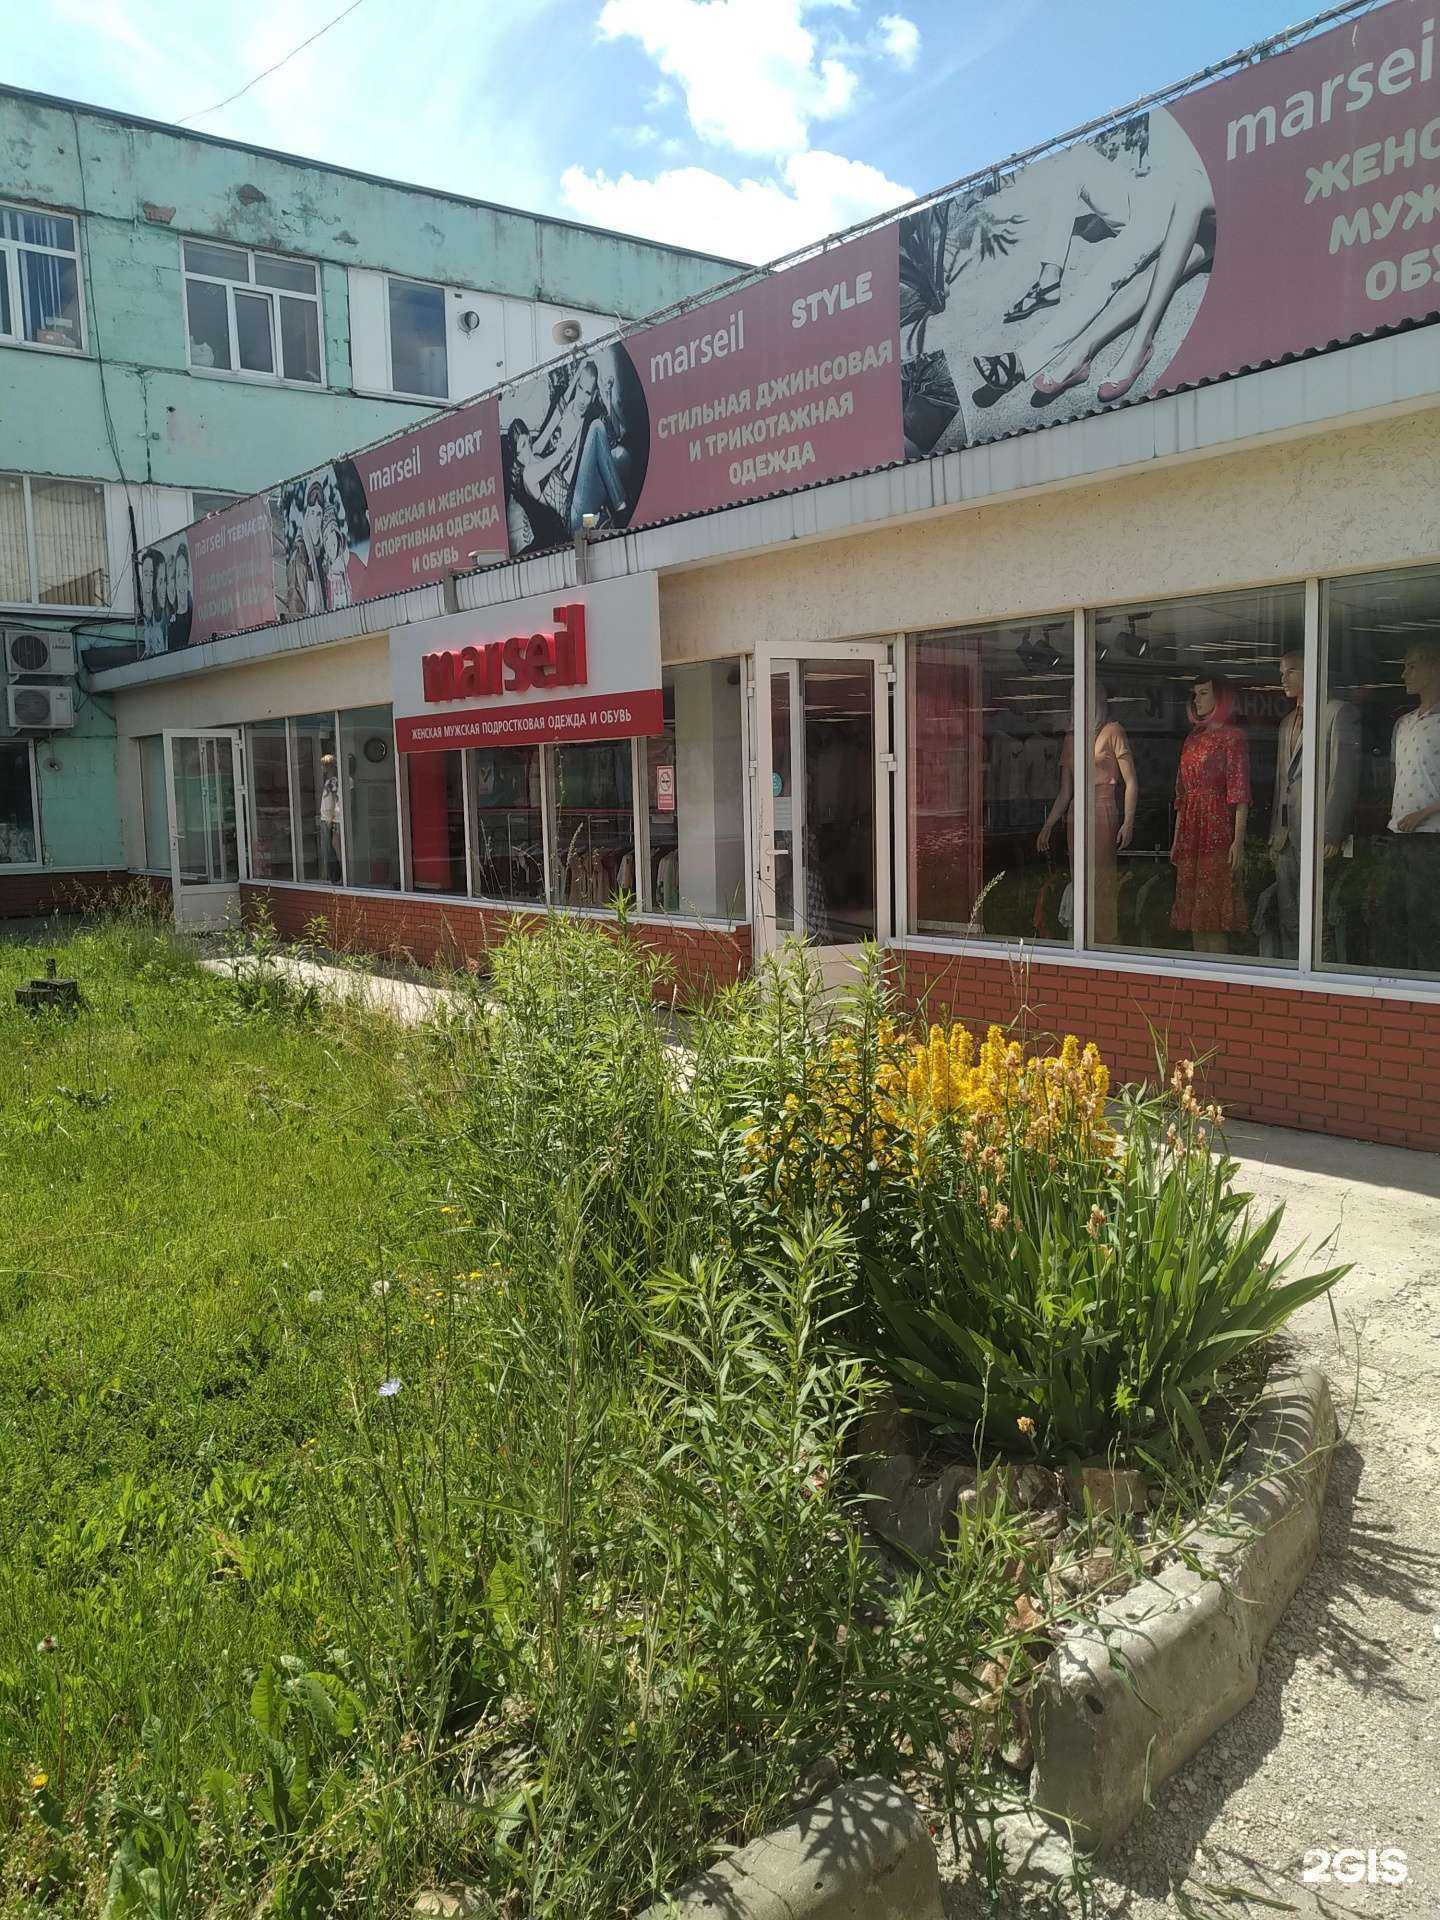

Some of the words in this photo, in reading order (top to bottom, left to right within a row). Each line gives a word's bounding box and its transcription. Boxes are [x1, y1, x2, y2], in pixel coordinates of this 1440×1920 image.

[650, 309, 745, 384] marseil
[791, 270, 874, 329] STYLE
[657, 388, 751, 439] СТИЛЬНАЯ
[755, 339, 893, 411] ДЖИНСОВАЯ
[688, 439, 702, 462] И
[704, 391, 855, 456] ТРИКОТАЖНАЯ
[369, 445, 421, 492] marseil
[438, 430, 482, 466] SPORT
[728, 441, 816, 486] ОДЕЖДА
[374, 501, 426, 534] МУЖСКАЯ
[428, 499, 436, 515] И
[438, 476, 496, 510] ЖЕНСКАЯ
[375, 523, 444, 558] СПОРТИВНАЯ
[446, 505, 500, 539] ОДЕЖДА
[412, 556, 420, 574] И
[422, 547, 459, 571] ОБУВЬ
[421, 604, 588, 703] marseil
[411, 726, 442, 740] ЖЕНСКАЯ
[443, 723, 480, 737] МУЖСКАЯ
[482, 716, 545, 735] ПОДРОСТКОВАЯ
[547, 712, 587, 730] ОДЕЖДА
[590, 711, 598, 725] И
[600, 708, 632, 724] ОБУВЬ
